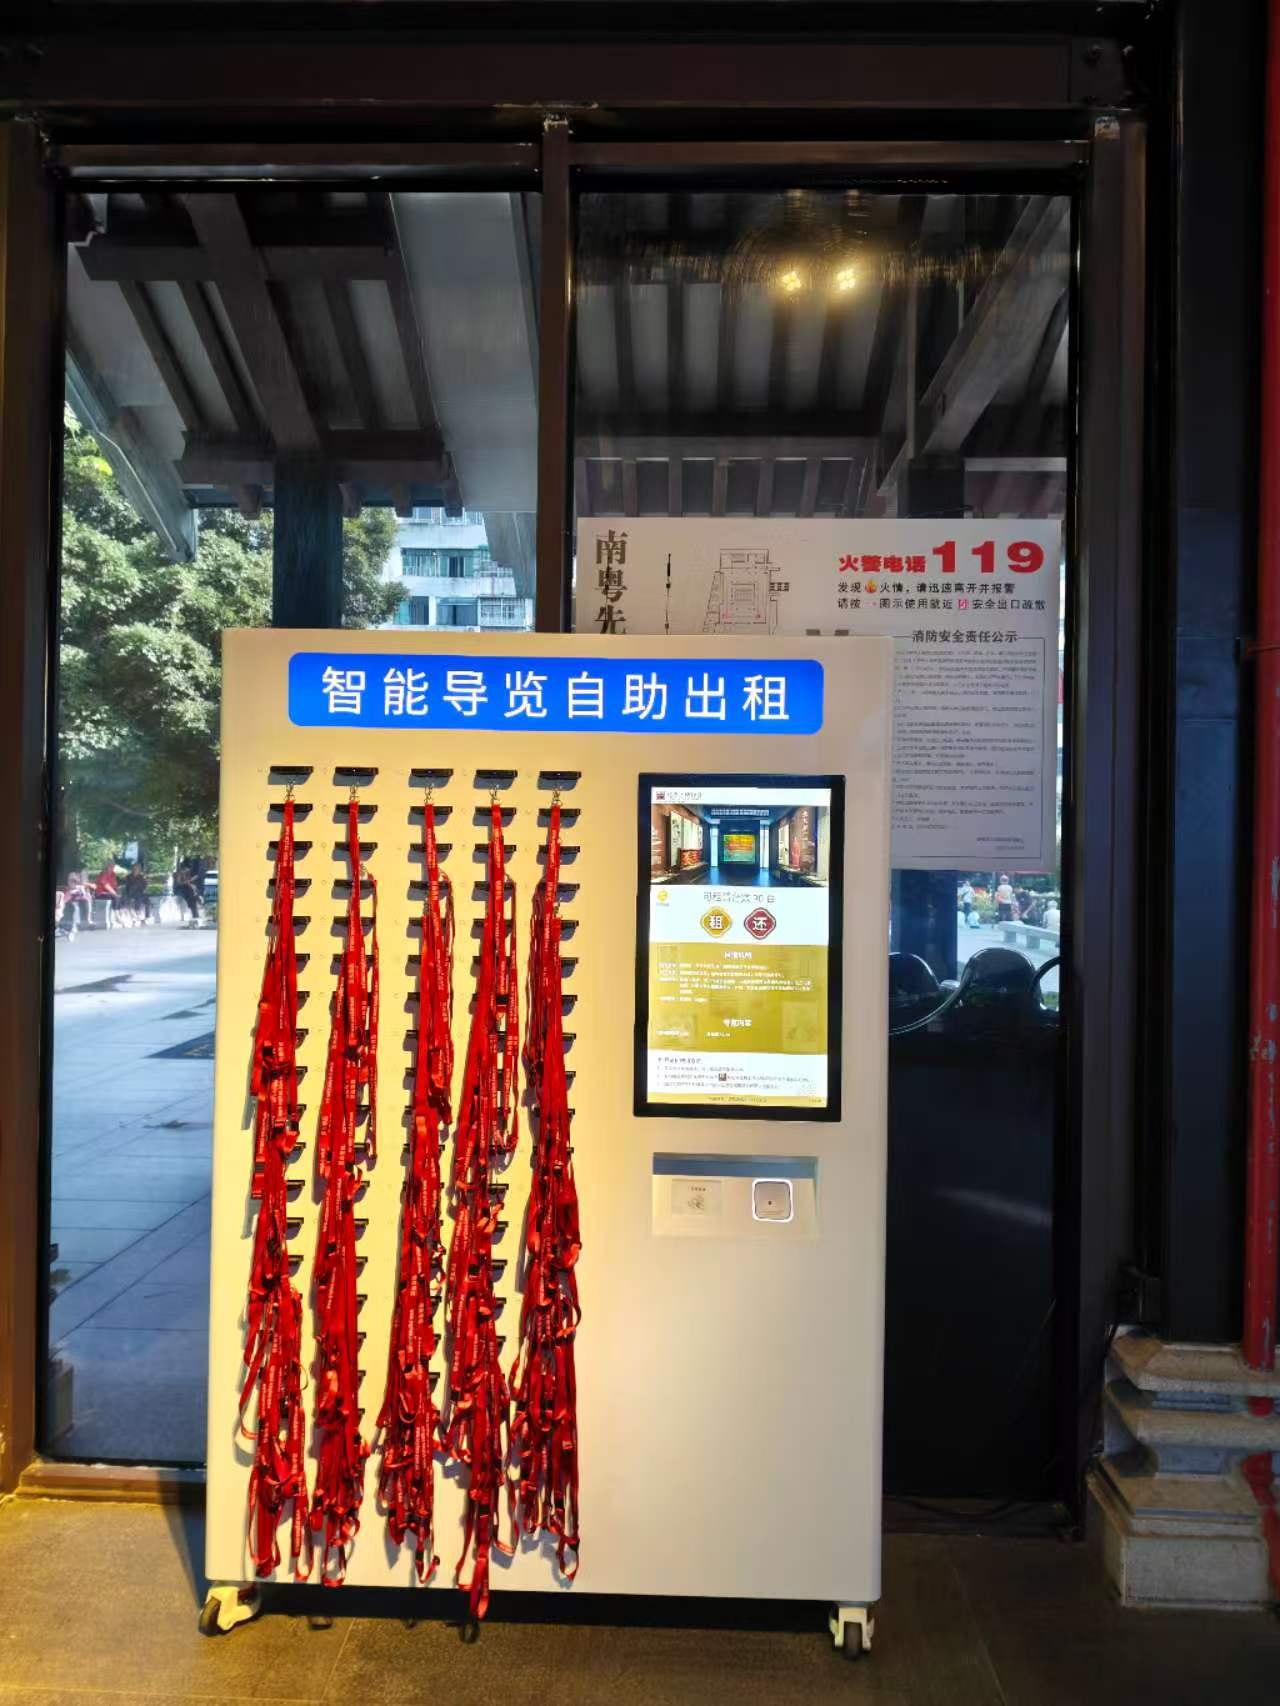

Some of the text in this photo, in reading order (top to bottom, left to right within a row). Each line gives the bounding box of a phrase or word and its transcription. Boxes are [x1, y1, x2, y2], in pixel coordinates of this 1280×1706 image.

[839, 541, 1044, 573] 火警电话 119
[912, 630, 1018, 643] 消防安全责任公示
[322, 666, 789, 722] 智能导览自助出租
